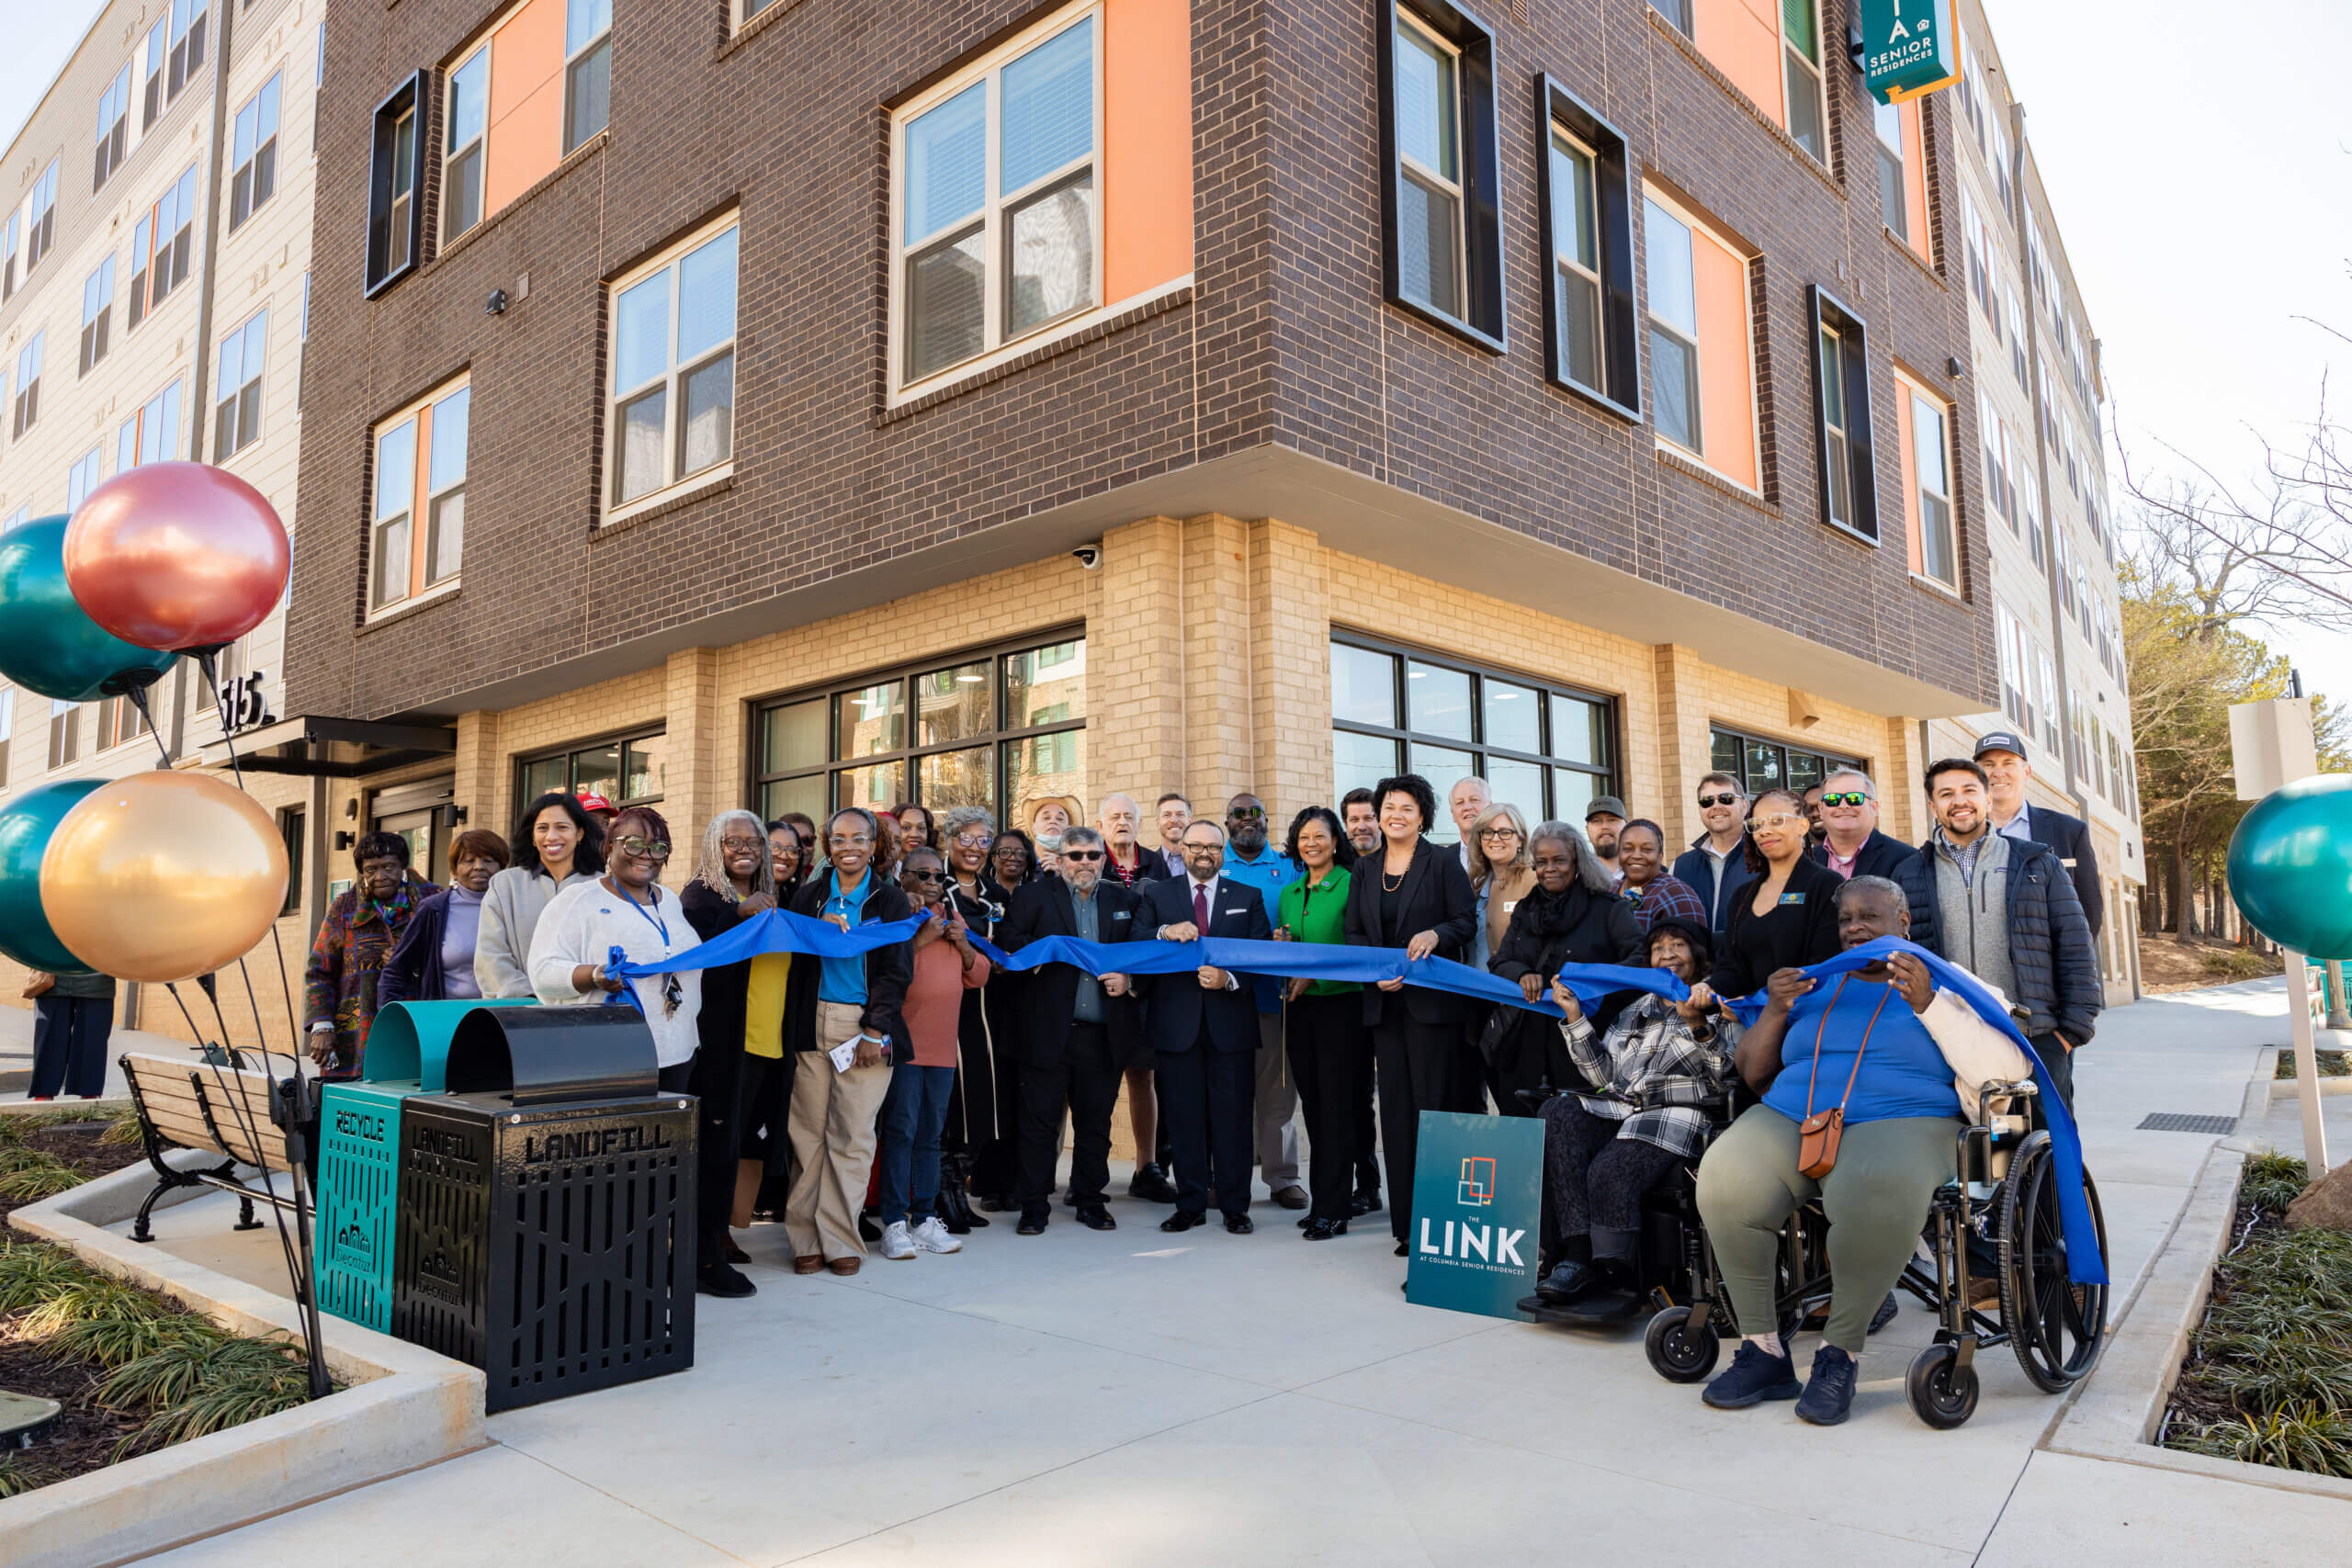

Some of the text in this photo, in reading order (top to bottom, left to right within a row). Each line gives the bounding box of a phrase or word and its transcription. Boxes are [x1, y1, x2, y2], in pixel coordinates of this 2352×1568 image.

[1870, 37, 1932, 68] SENIOR
[1871, 49, 1933, 78] RESIDENCES
[336, 1110, 385, 1143] RECYCLE
[412, 1124, 479, 1165] LANDFILL
[526, 1124, 672, 1164] LANDFILL
[1419, 1217, 1526, 1267] LINK
[336, 1248, 371, 1274] Decatur
[1429, 1257, 1459, 1266] COLUMBIA
[1462, 1261, 1485, 1270] SENIOR
[1487, 1265, 1525, 1276] RESIDENCES
[418, 1278, 460, 1307] Decatur
